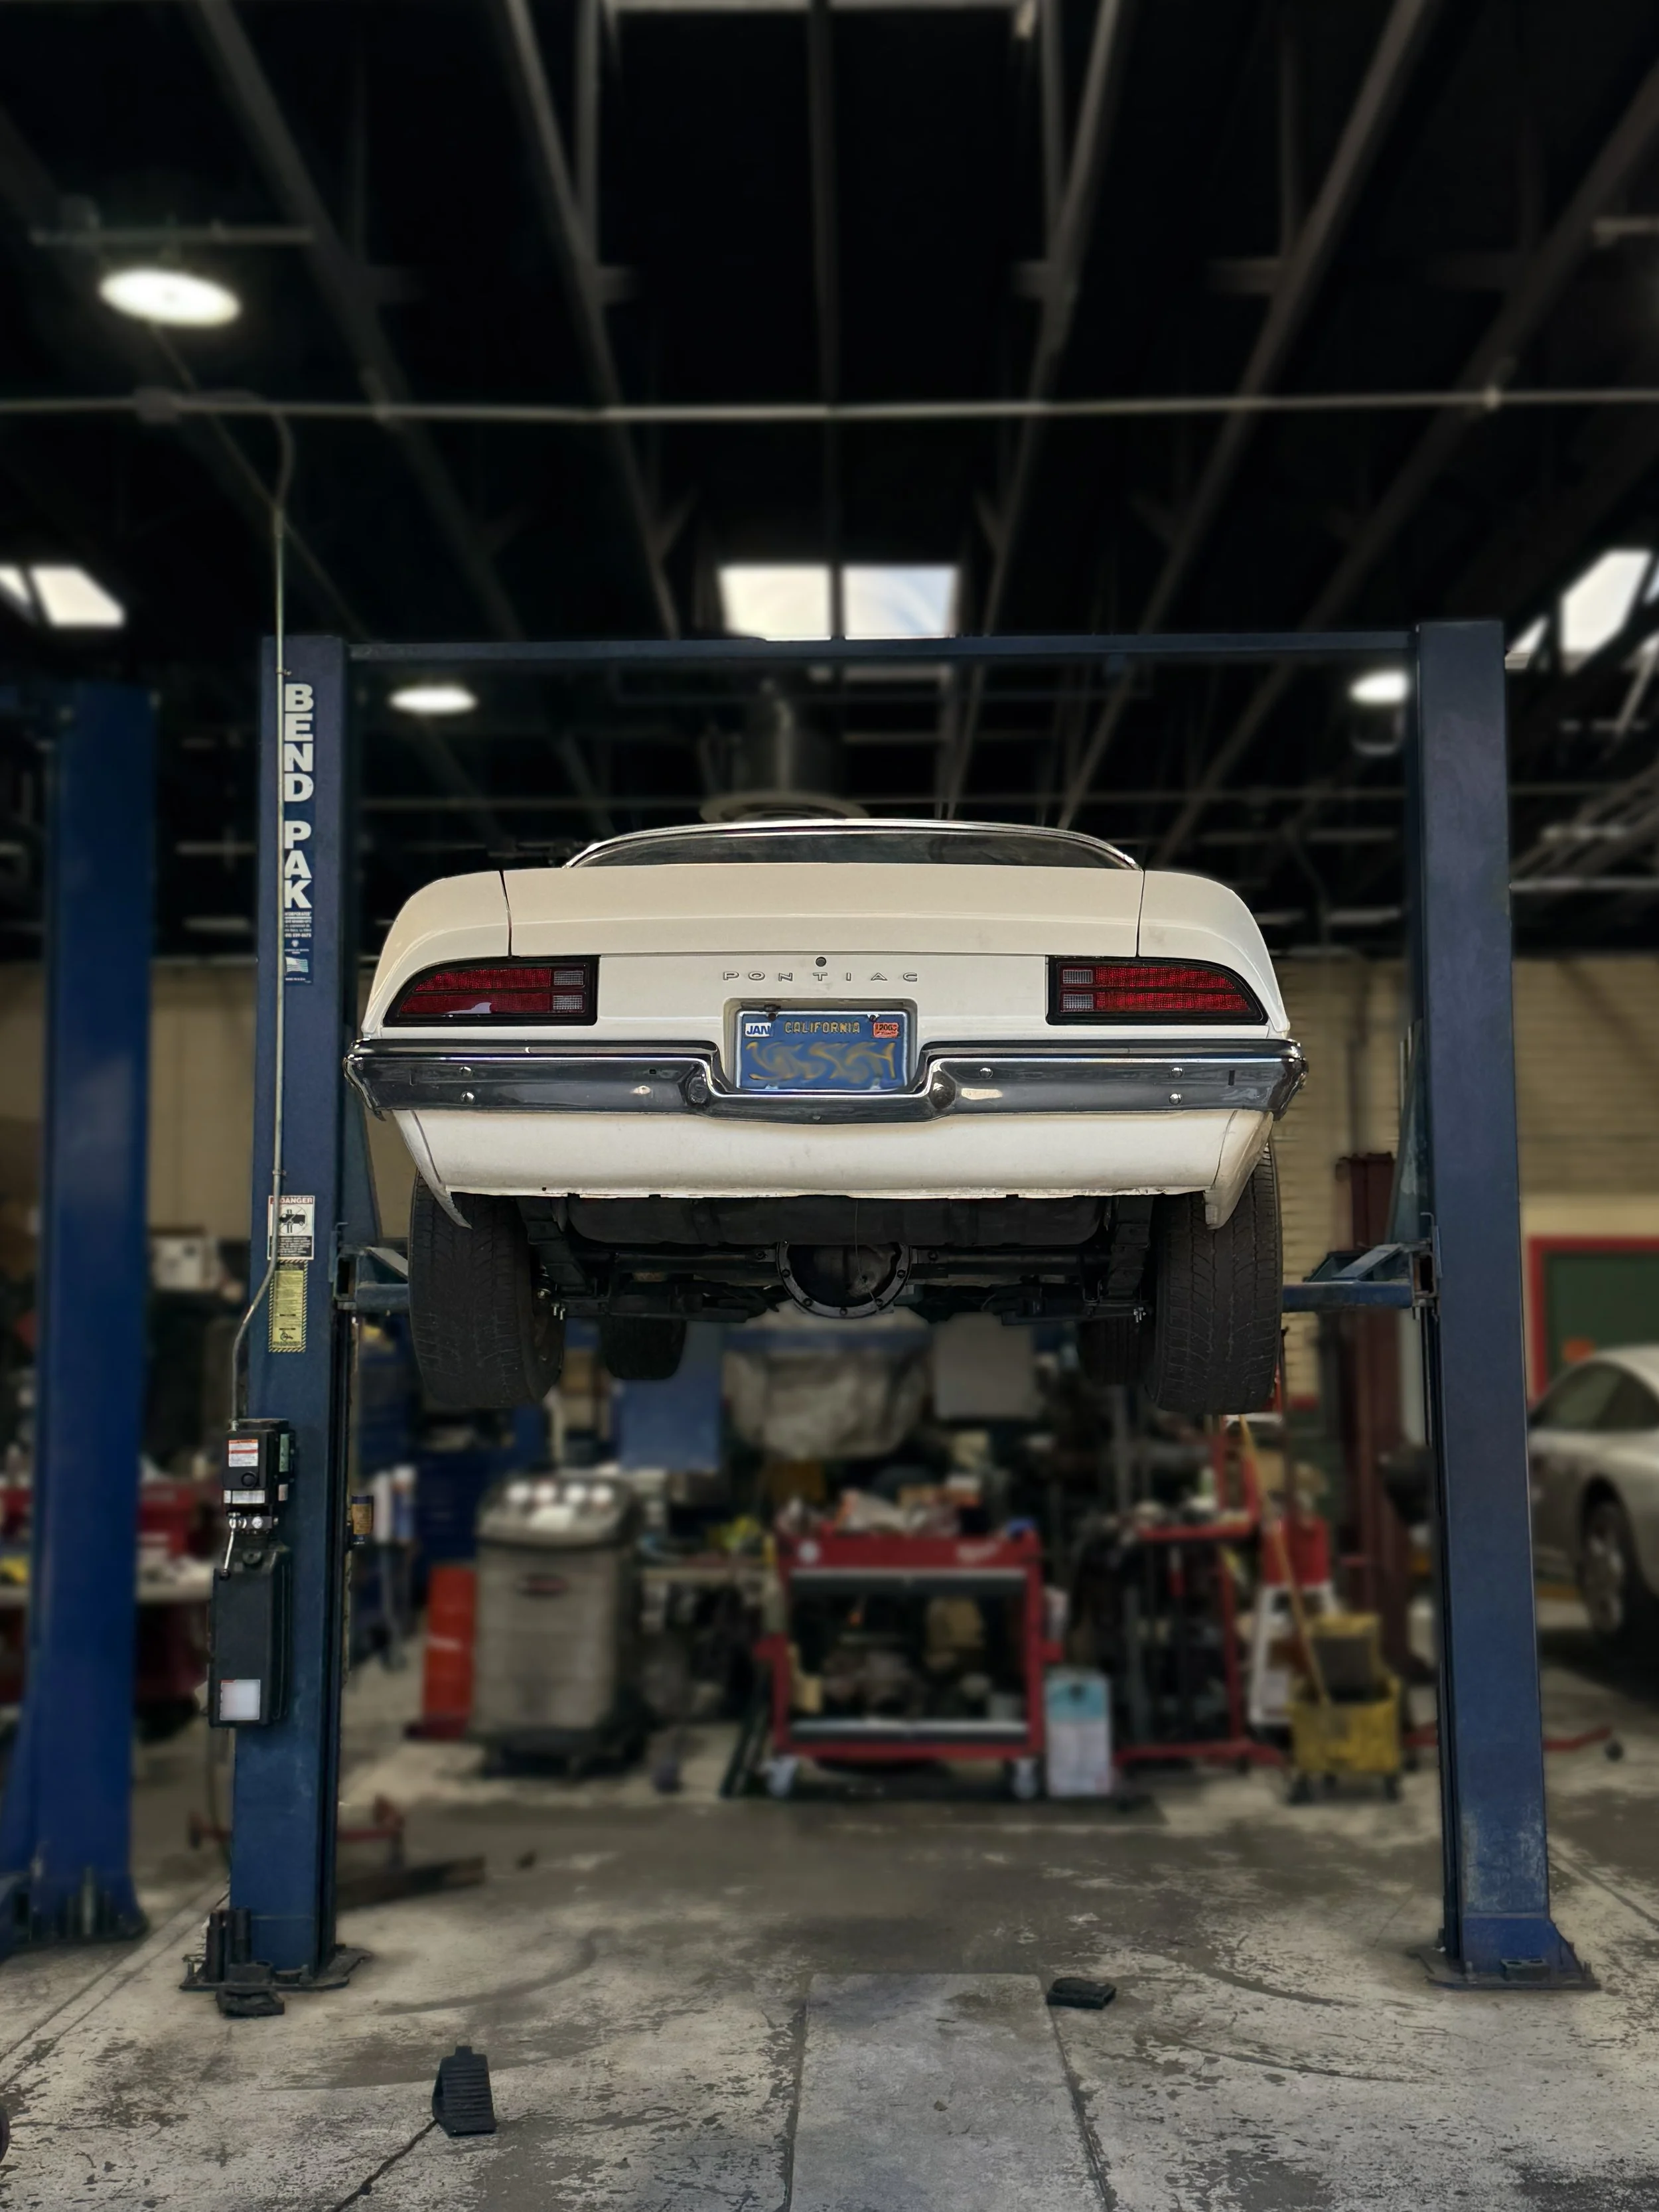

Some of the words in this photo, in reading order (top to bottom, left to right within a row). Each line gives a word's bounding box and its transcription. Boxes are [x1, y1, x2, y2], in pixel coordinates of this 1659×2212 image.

[284, 684, 314, 802] BEND
[284, 820, 313, 908] PAK
[723, 972, 918, 982] PONTIAC
[747, 1025, 772, 1035] JAN
[784, 1021, 861, 1034] CALIFORNIA
